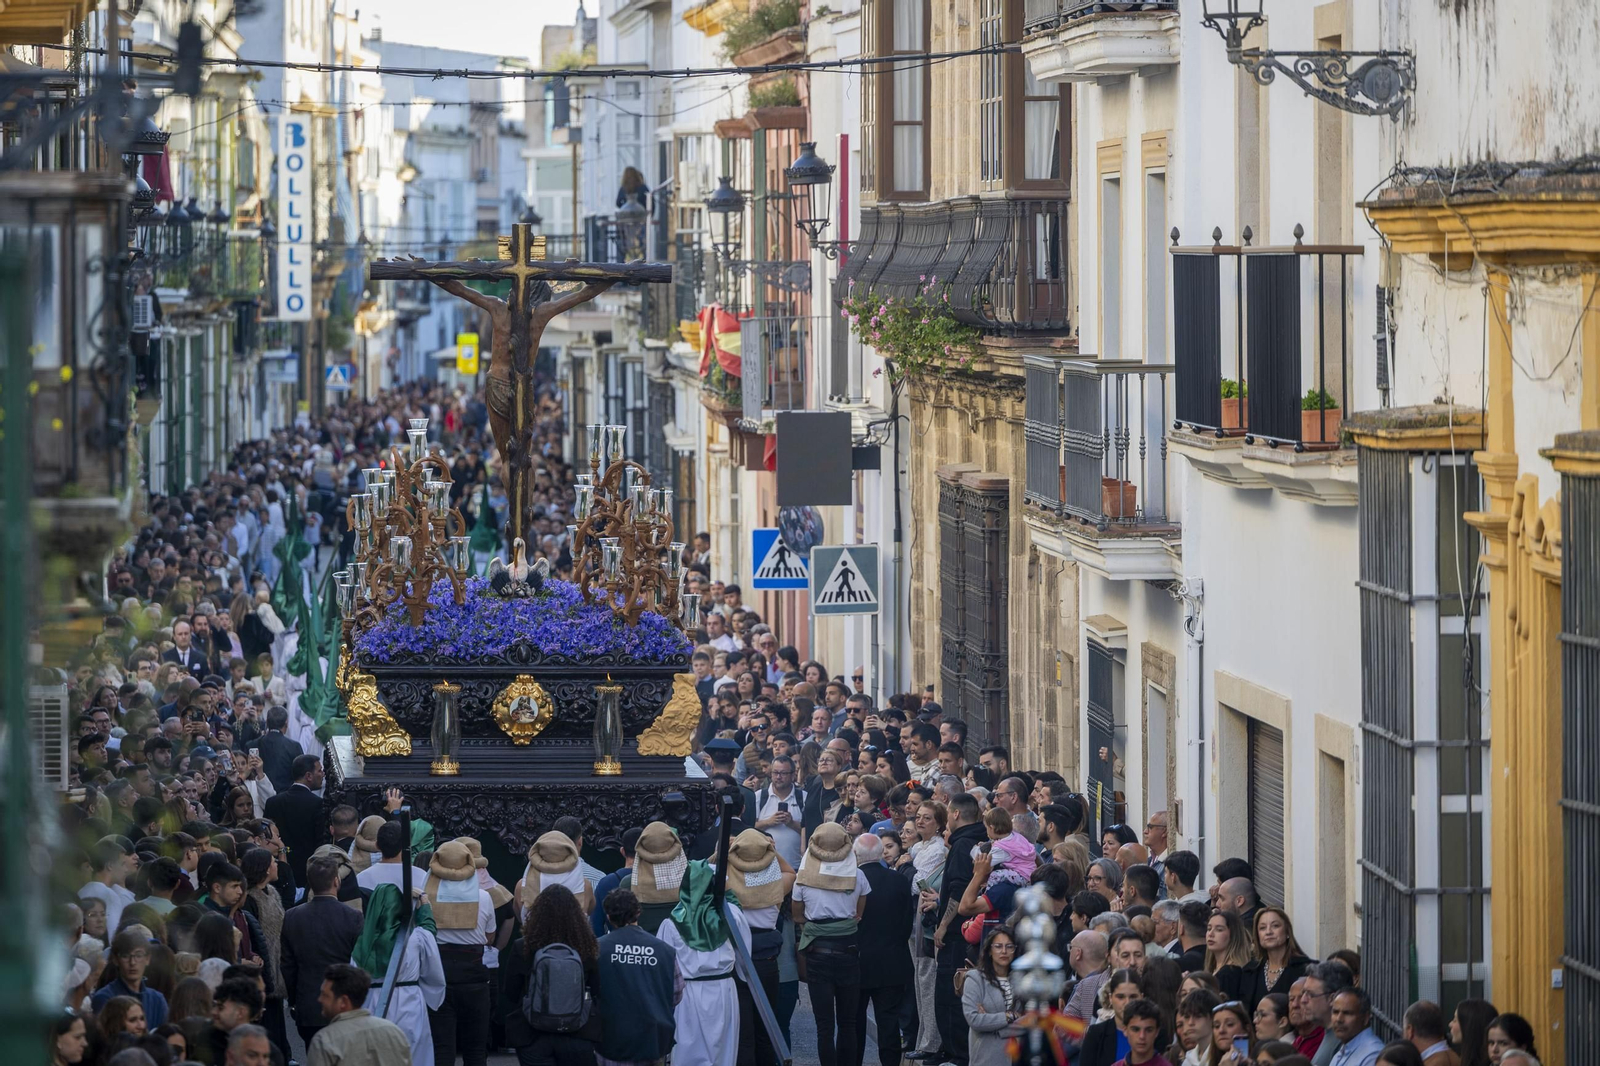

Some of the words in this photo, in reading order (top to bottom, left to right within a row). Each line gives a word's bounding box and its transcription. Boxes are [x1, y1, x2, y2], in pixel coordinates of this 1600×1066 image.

[285, 122, 306, 312] BOLLULLO
[615, 944, 655, 956] RADIO
[610, 953, 658, 966] PUERTO
